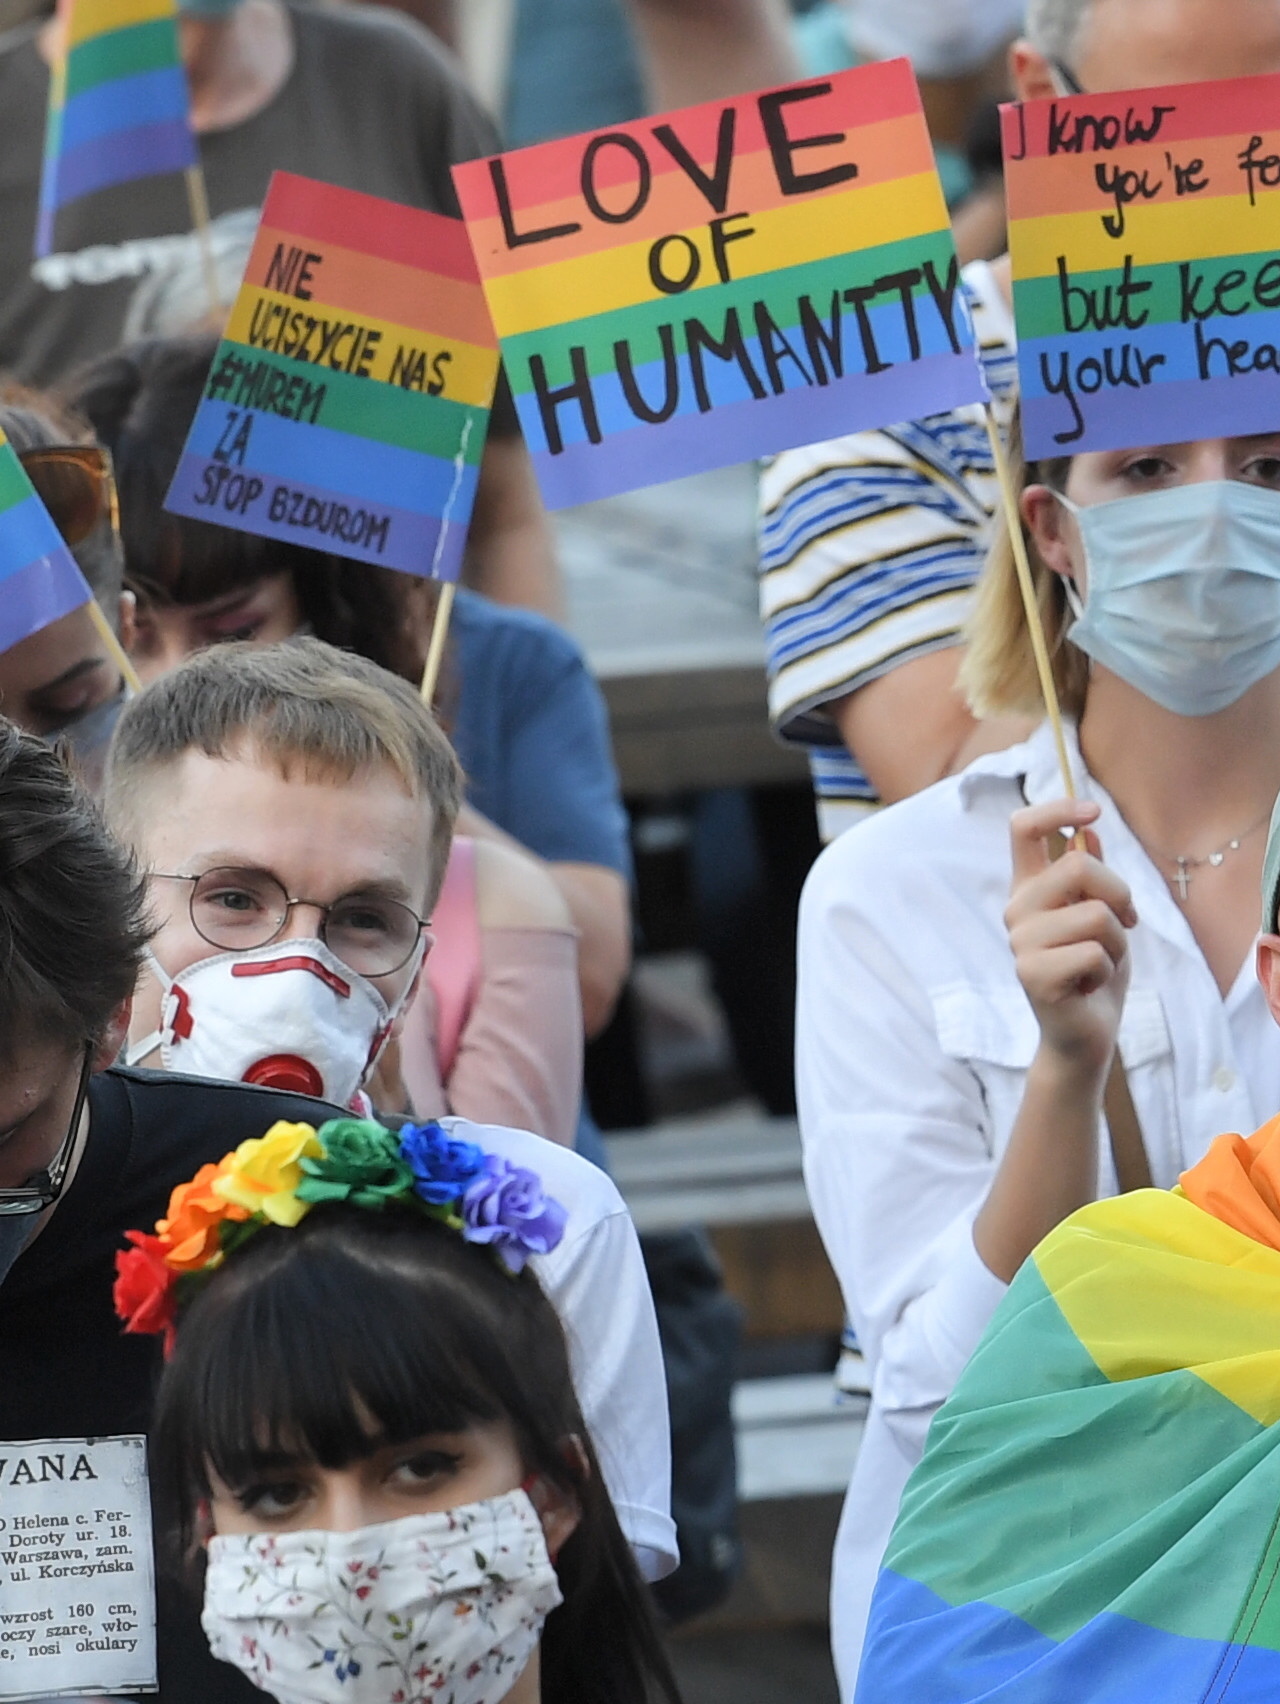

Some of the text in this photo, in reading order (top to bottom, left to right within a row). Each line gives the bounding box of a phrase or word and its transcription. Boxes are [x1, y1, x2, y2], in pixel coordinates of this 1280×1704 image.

[1047, 104, 1176, 155] know
[489, 82, 858, 249] LOVE
[1095, 151, 1209, 238] you're
[264, 243, 323, 301] NIE
[648, 212, 755, 294] OF
[1056, 255, 1152, 333] but
[248, 298, 453, 397] UCISZYCIE NAS
[528, 254, 962, 455] HUMANITY
[207, 351, 327, 425] #MUREM
[1040, 343, 1166, 444] your
[212, 410, 254, 466] ZA
[193, 465, 391, 553] STOP BZDUROM
[9, 1525, 132, 1548] Doroty ur. 18.
[13, 1514, 69, 1530] Helena
[76, 1515, 88, 1525] c.
[94, 1509, 131, 1523] Fer-
[1, 1544, 133, 1566] Warszawa, zam.
[10, 1559, 134, 1581] ul. Korczyńska
[0, 1603, 137, 1624] wzrost 160 cm,
[1, 1618, 138, 1642] oczy szare, wło-
[28, 1641, 61, 1656] nosi
[76, 1637, 138, 1653] okulary
